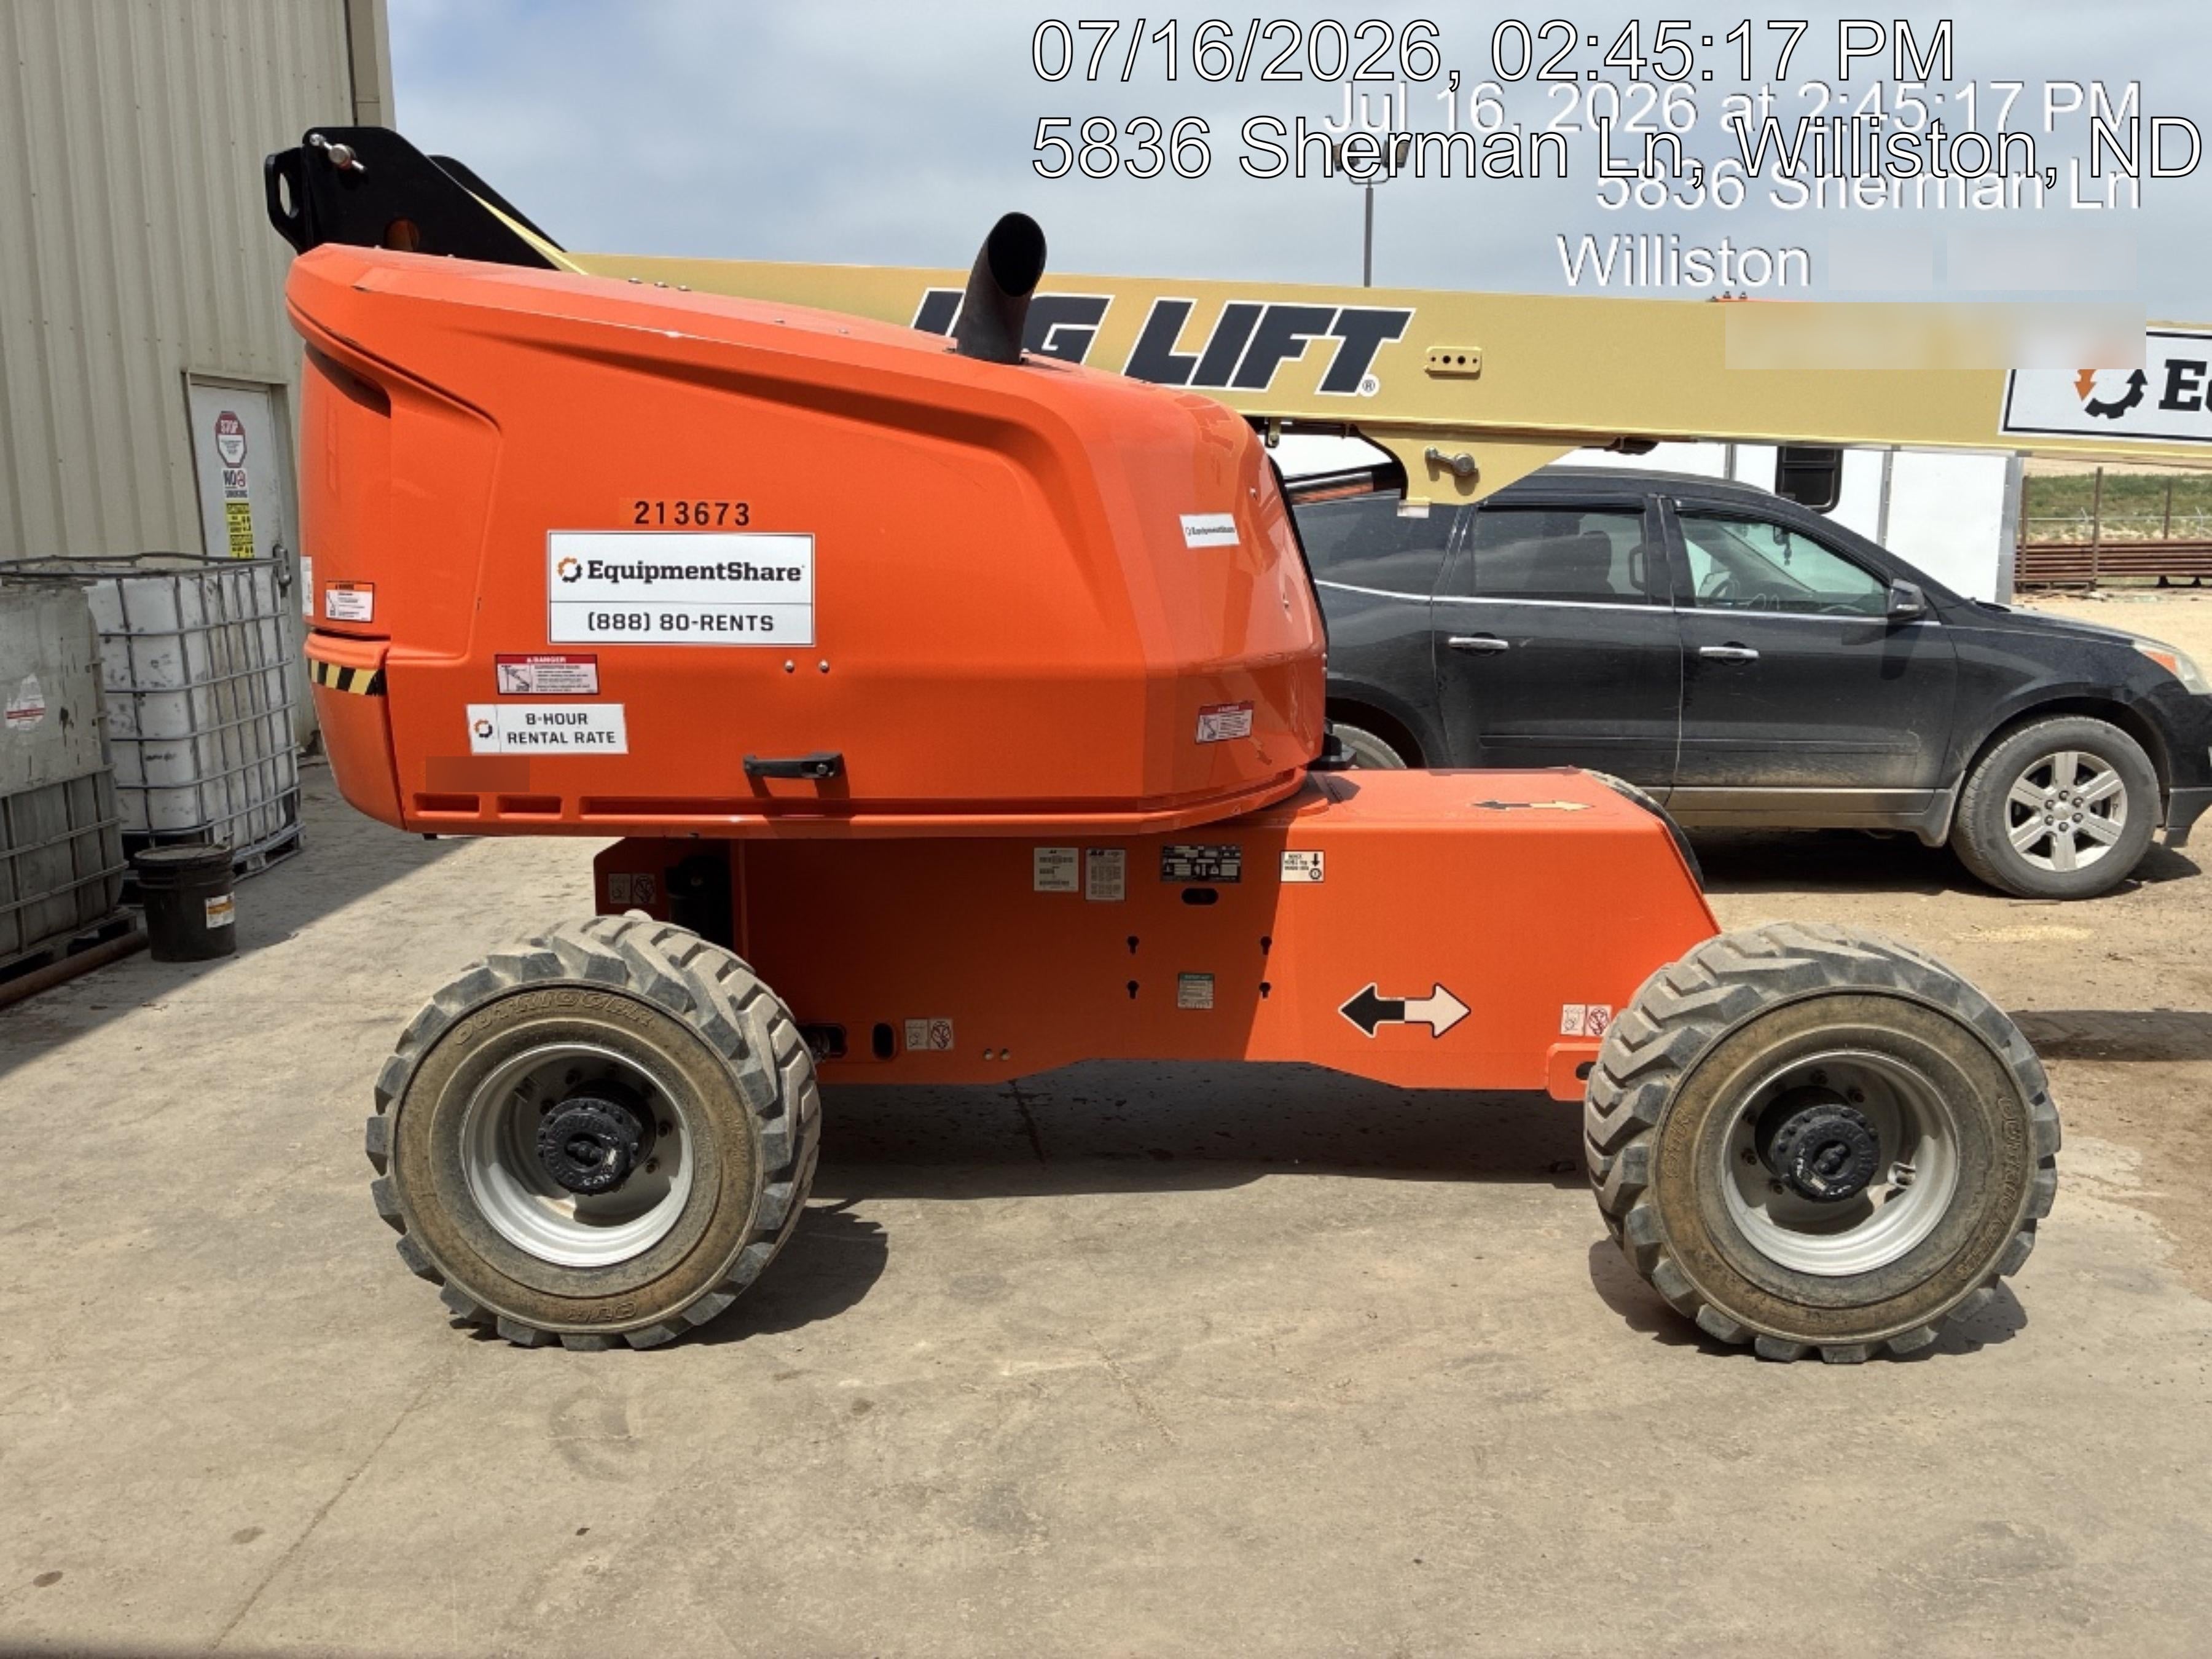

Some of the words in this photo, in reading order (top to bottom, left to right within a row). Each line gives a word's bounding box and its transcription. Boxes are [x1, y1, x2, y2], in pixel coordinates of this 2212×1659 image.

[2158, 358, 2212, 412] E
[633, 501, 750, 526] 213673
[587, 560, 801, 583] EquipmentShare
[587, 611, 651, 631] (888)
[659, 614, 774, 632] 80-RENTS
[525, 713, 589, 726] 8-HOUR
[506, 731, 568, 744] RENTAL
[574, 731, 616, 744] RATE
